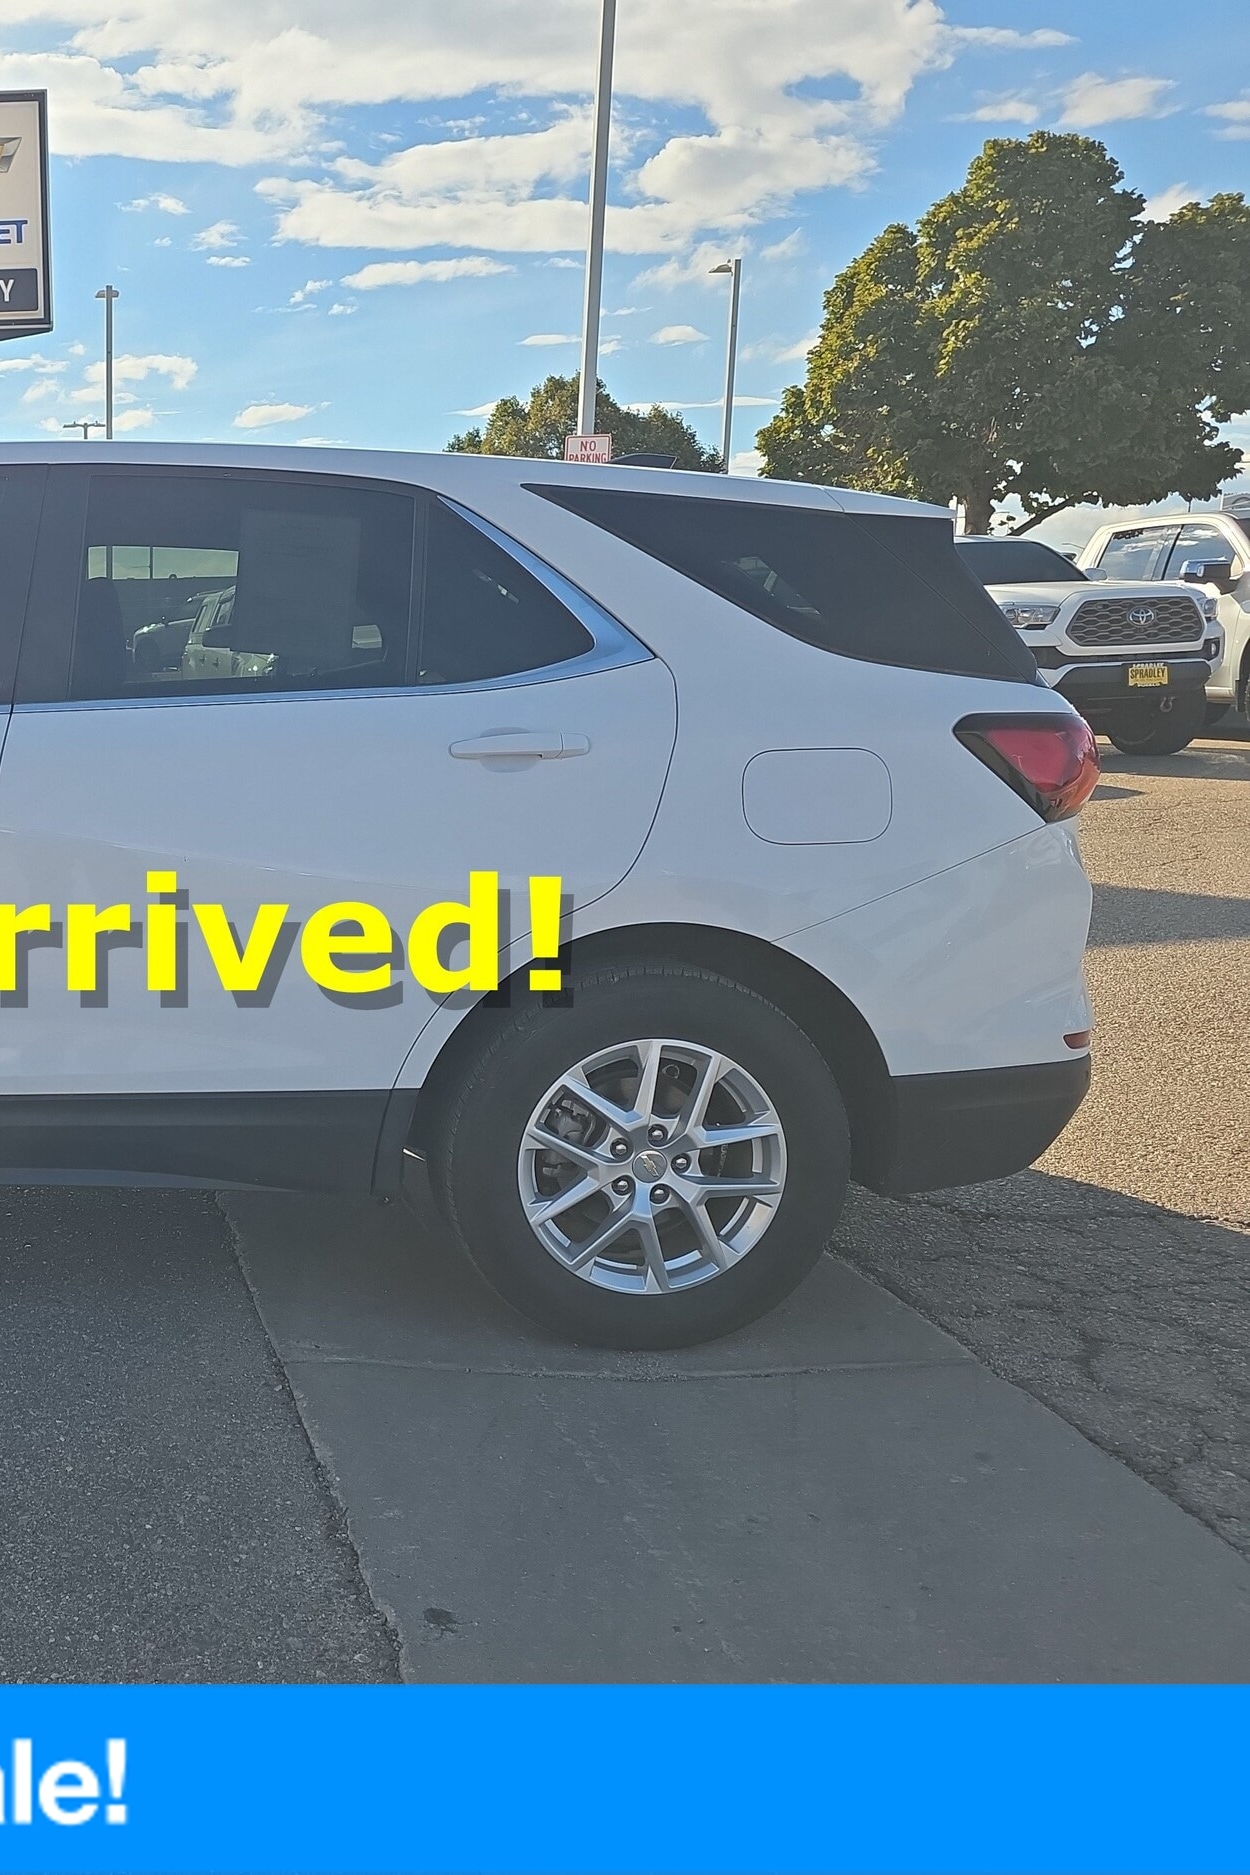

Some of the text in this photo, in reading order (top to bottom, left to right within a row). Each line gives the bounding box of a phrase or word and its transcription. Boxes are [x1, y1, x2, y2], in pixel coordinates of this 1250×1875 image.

[580, 441, 597, 451] NO
[569, 453, 607, 463] PARKING
[1130, 668, 1166, 679] SPRADLEY
